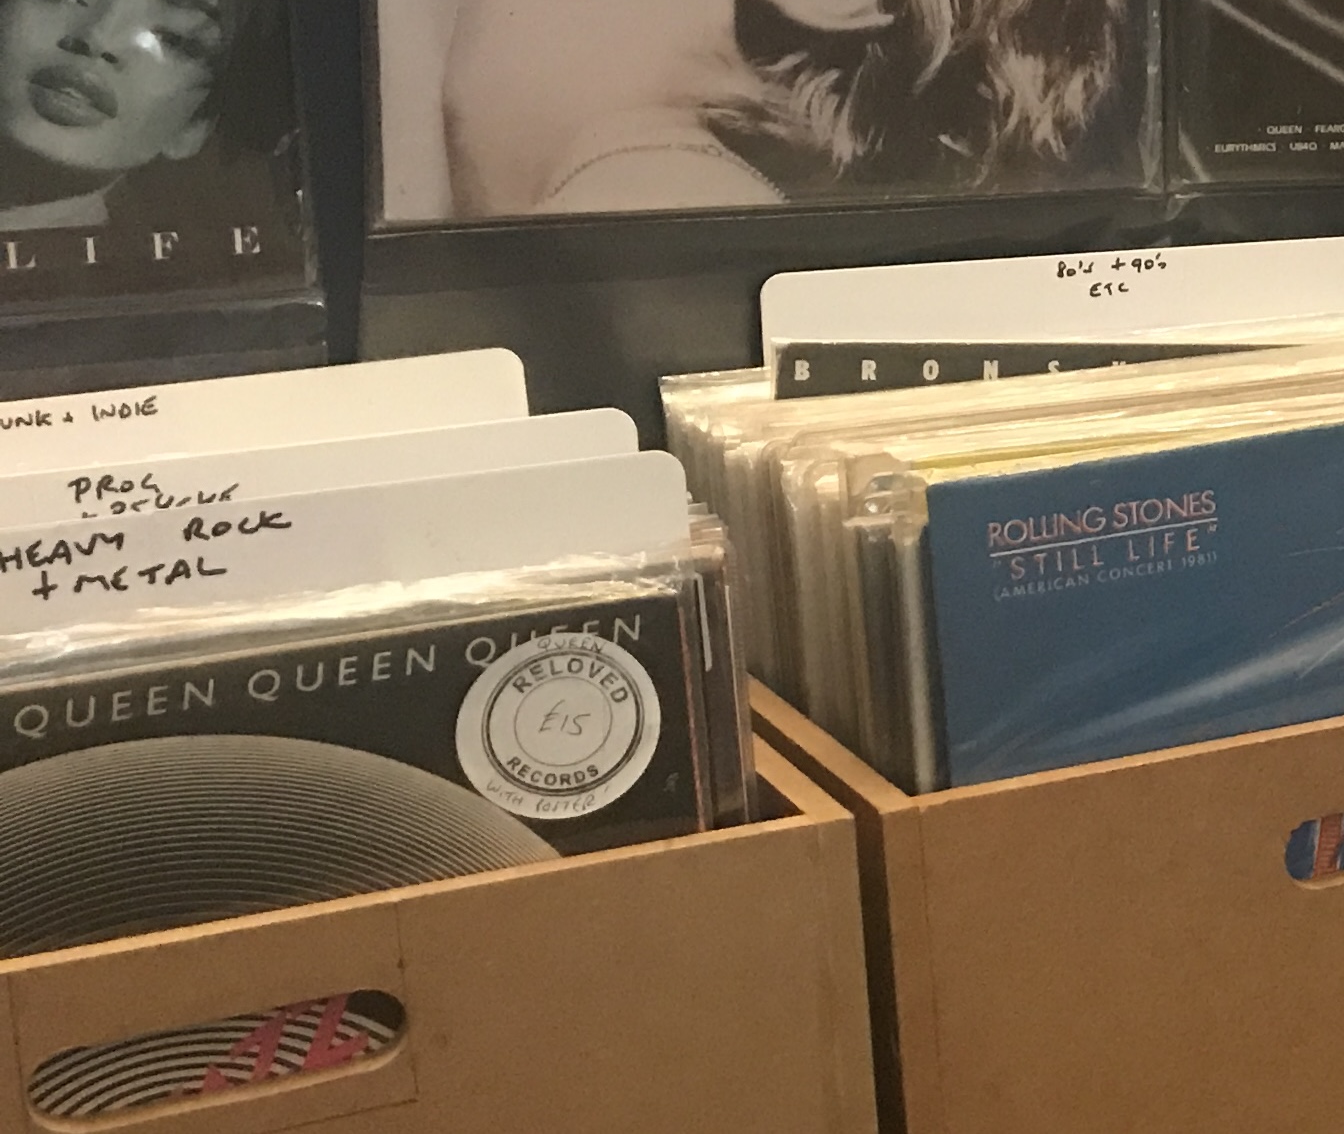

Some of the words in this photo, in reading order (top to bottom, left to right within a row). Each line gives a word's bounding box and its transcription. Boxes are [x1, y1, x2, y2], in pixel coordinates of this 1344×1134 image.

[1266, 124, 1303, 135] QUEEN
[2, 226, 261, 270] LIFE
[794, 359, 1127, 382] BRONS
[91, 395, 160, 422] INDIE
[67, 471, 161, 505] PROG
[986, 505, 1107, 548] ROLLING
[1111, 488, 1218, 530] STONES
[0, 531, 126, 573] HEAVY
[182, 509, 293, 543] ROCK
[72, 555, 229, 594] METAL
[1096, 556, 1173, 584] CONCERT
[12, 677, 217, 740] QUEEN
[246, 642, 438, 704] QUEEN
[511, 657, 630, 705] RELOVED
[537, 698, 592, 736] £15
[505, 755, 600, 787] RECORDS
